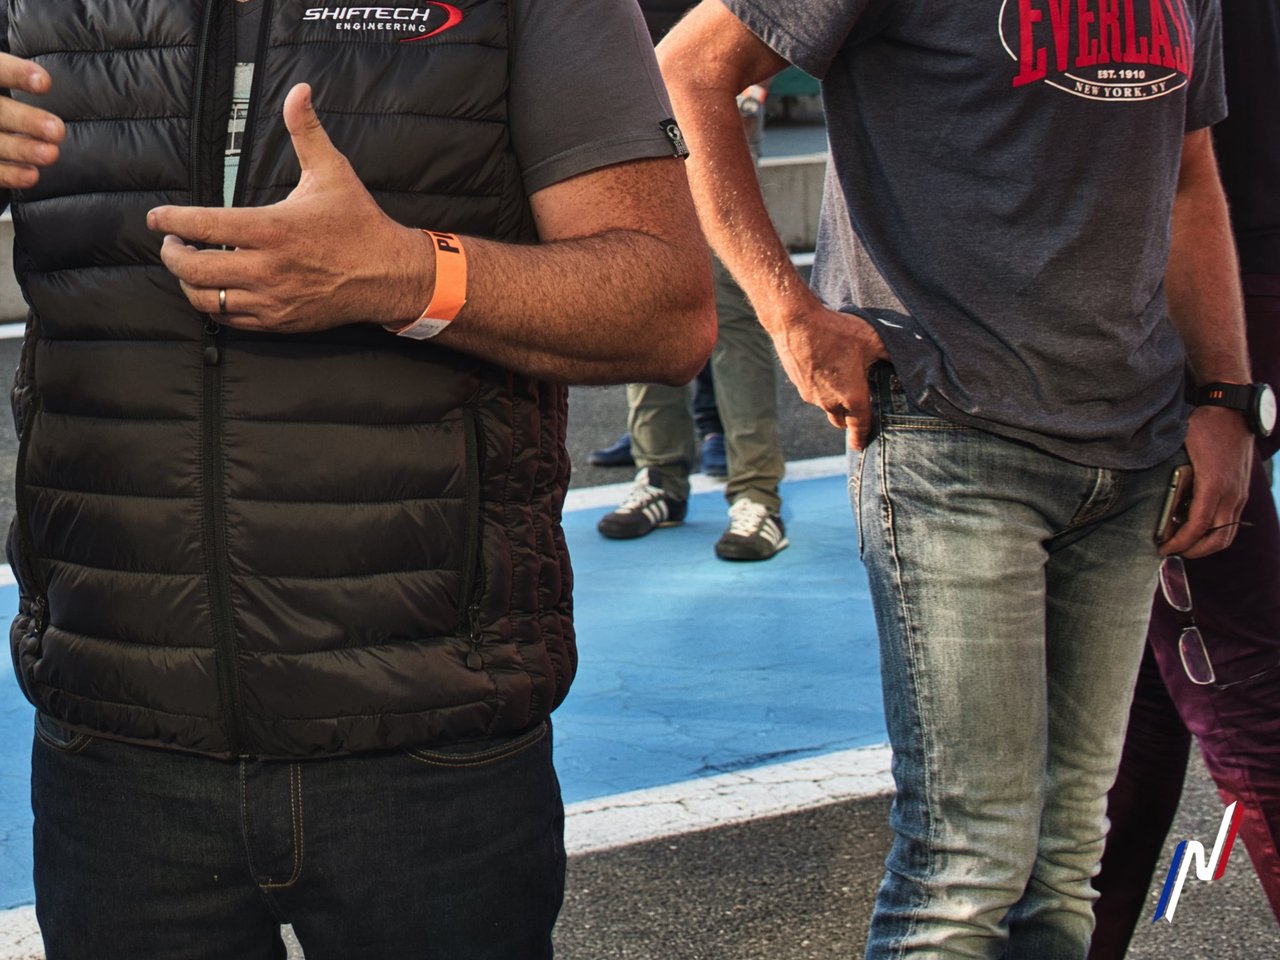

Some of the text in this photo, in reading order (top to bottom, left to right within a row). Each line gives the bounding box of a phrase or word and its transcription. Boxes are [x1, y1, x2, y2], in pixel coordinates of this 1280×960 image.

[302, 7, 431, 22] SHIFTECH
[335, 22, 427, 33] ENGINEERING
[1097, 70, 1146, 79] EST. 1910
[1074, 81, 1100, 96] NEW
[1150, 81, 1167, 94] NY
